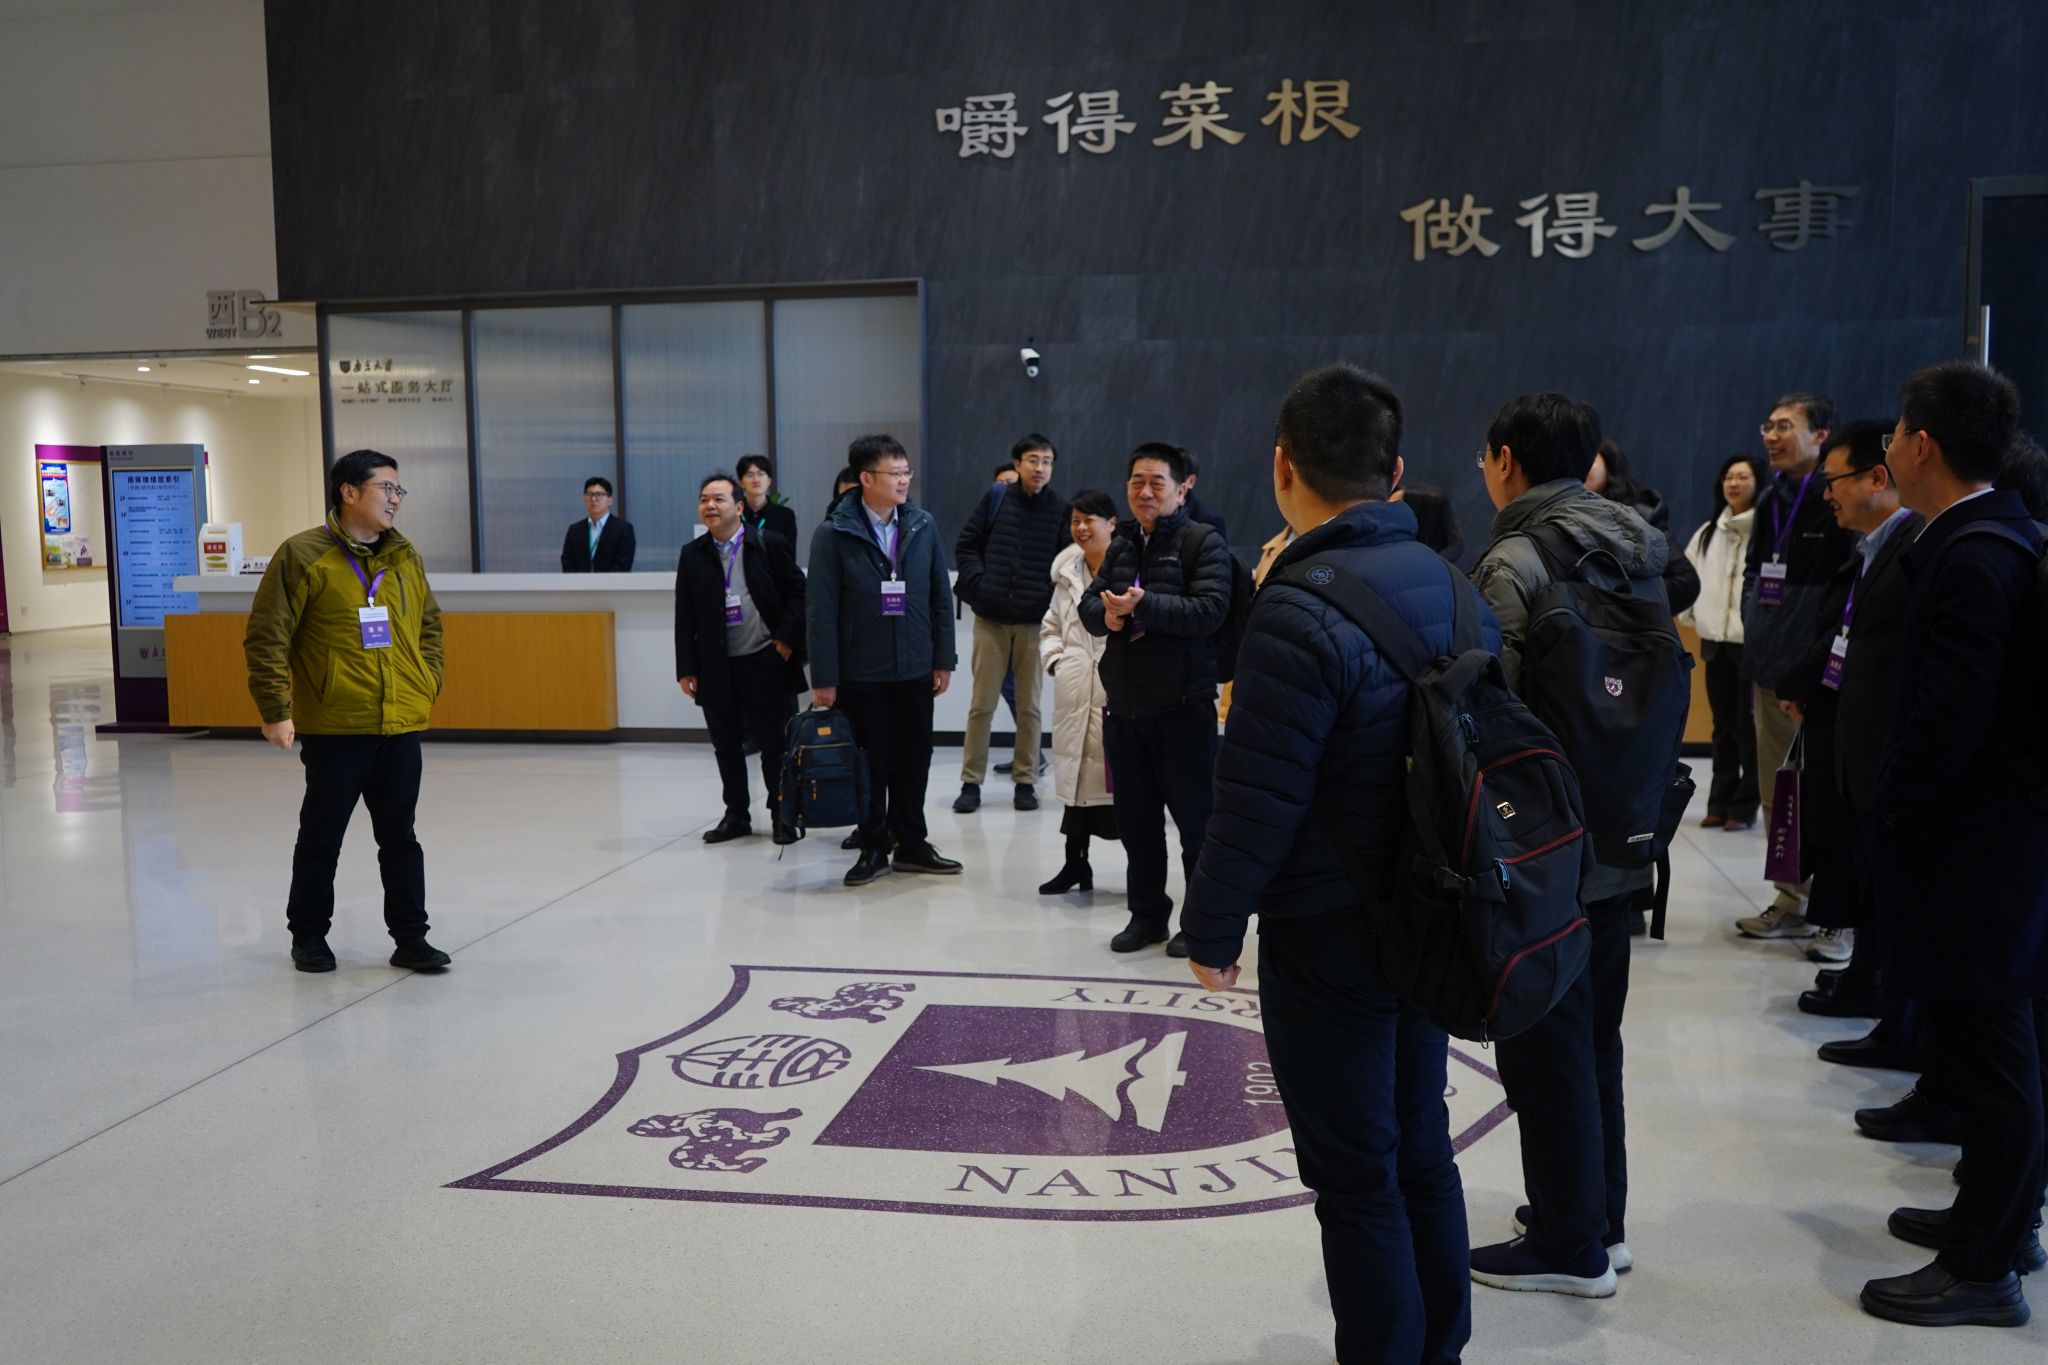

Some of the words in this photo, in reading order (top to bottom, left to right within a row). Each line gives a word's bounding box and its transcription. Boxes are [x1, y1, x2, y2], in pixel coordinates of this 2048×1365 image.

[936, 79, 1362, 159] 嚼得菜根
[1401, 179, 1861, 263] 做得大事
[206, 290, 236, 326] 西
[341, 379, 453, 395] 一站式服务大厅
[1244, 1062, 1283, 1107] 1902
[945, 1147, 1298, 1197] NANJI
